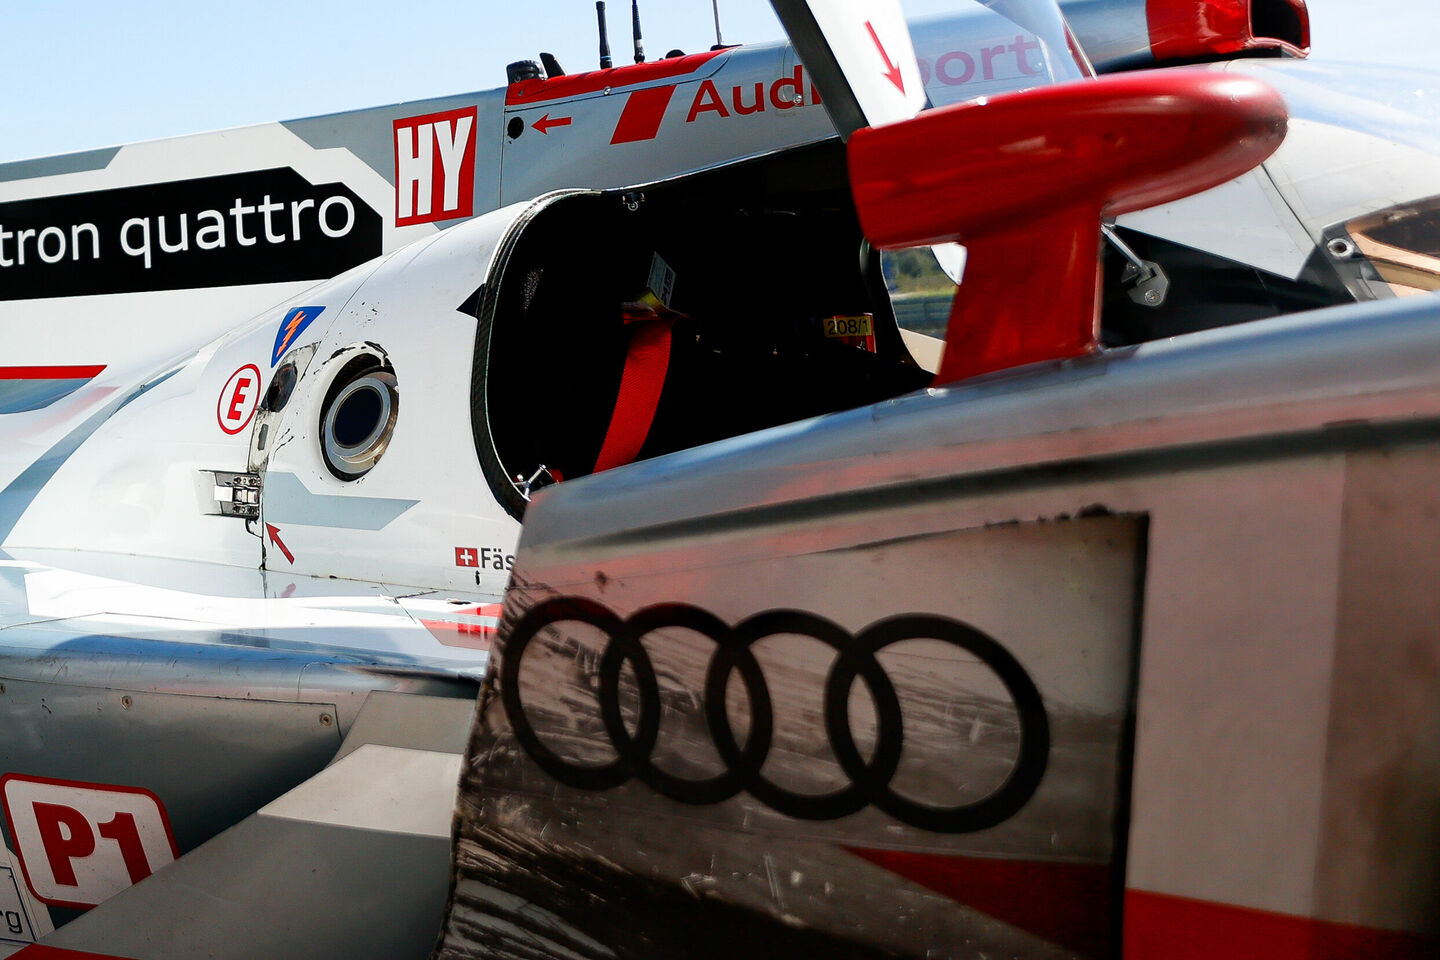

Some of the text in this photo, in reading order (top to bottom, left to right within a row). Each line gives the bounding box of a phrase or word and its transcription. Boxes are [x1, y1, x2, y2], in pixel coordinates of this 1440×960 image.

[396, 115, 475, 219] HY
[119, 194, 357, 269] quattro
[827, 319, 869, 336] 208/1
[227, 377, 252, 421] E
[481, 547, 516, 572] Fäs
[31, 800, 153, 887] P1
